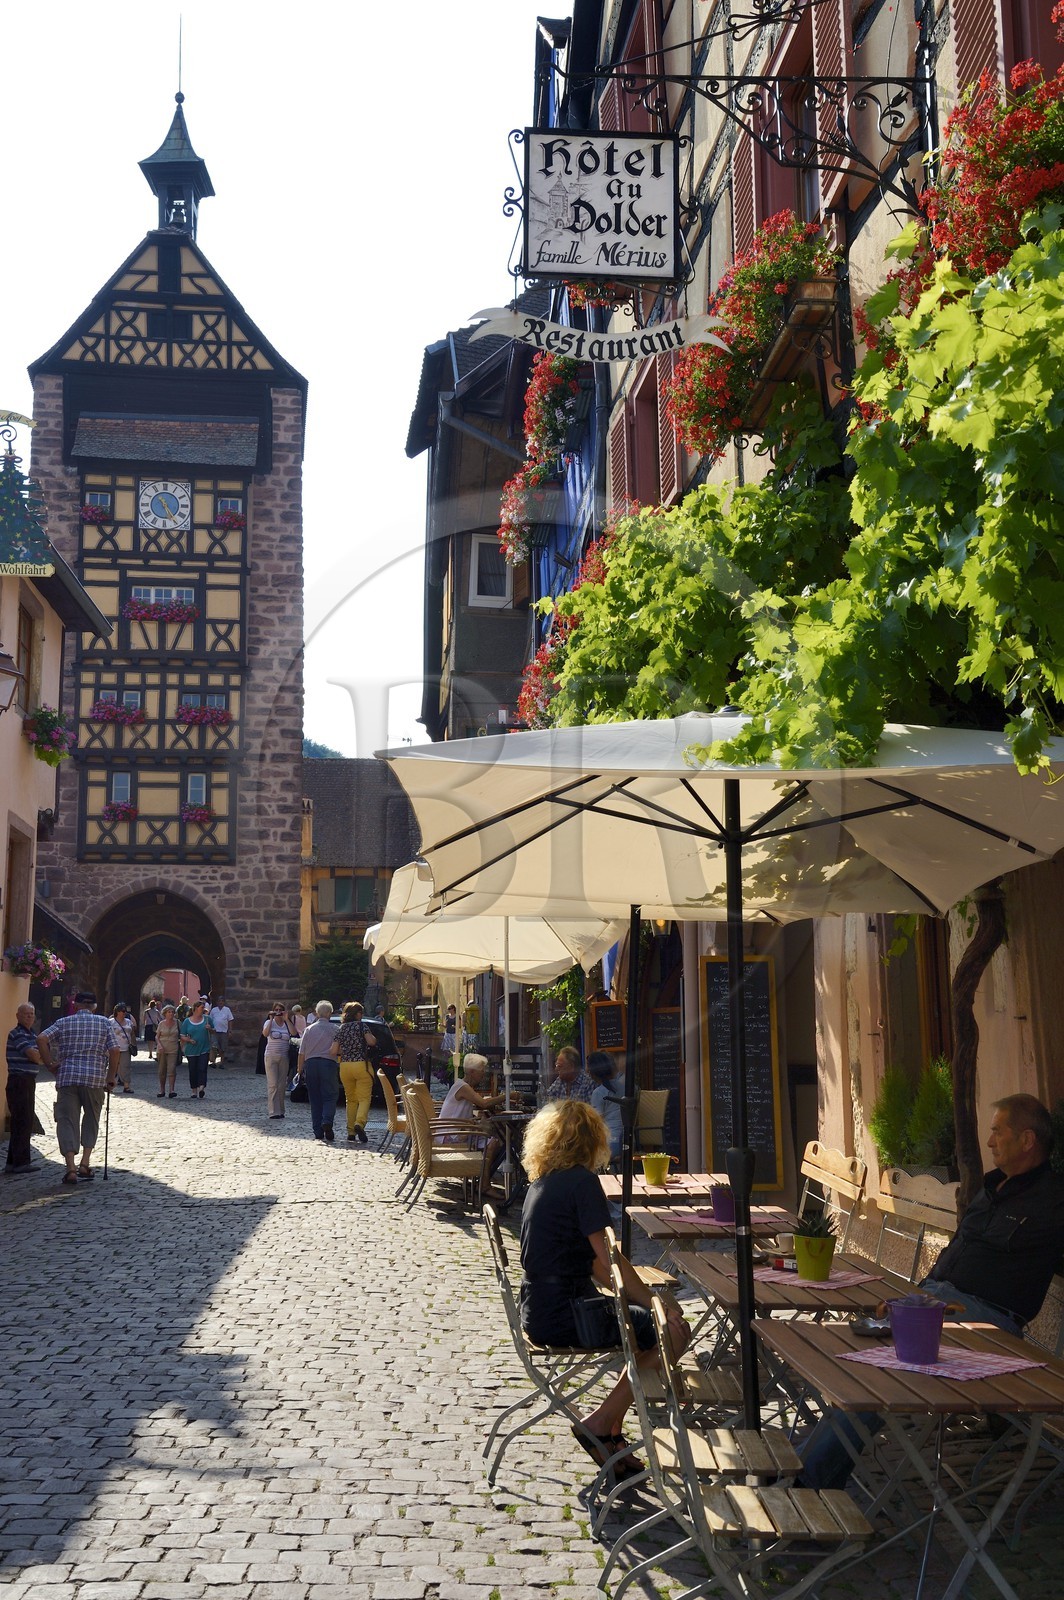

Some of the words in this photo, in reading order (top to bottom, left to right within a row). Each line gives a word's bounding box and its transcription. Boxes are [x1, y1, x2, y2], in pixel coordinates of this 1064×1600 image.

[538, 138, 666, 179] Hôtel
[605, 178, 643, 200] au
[562, 197, 669, 239] Dolder
[530, 239, 592, 269] famille
[593, 241, 670, 269] Mérius
[518, 317, 687, 361] Restaurant
[0, 564, 47, 576] Wohlfahrt
